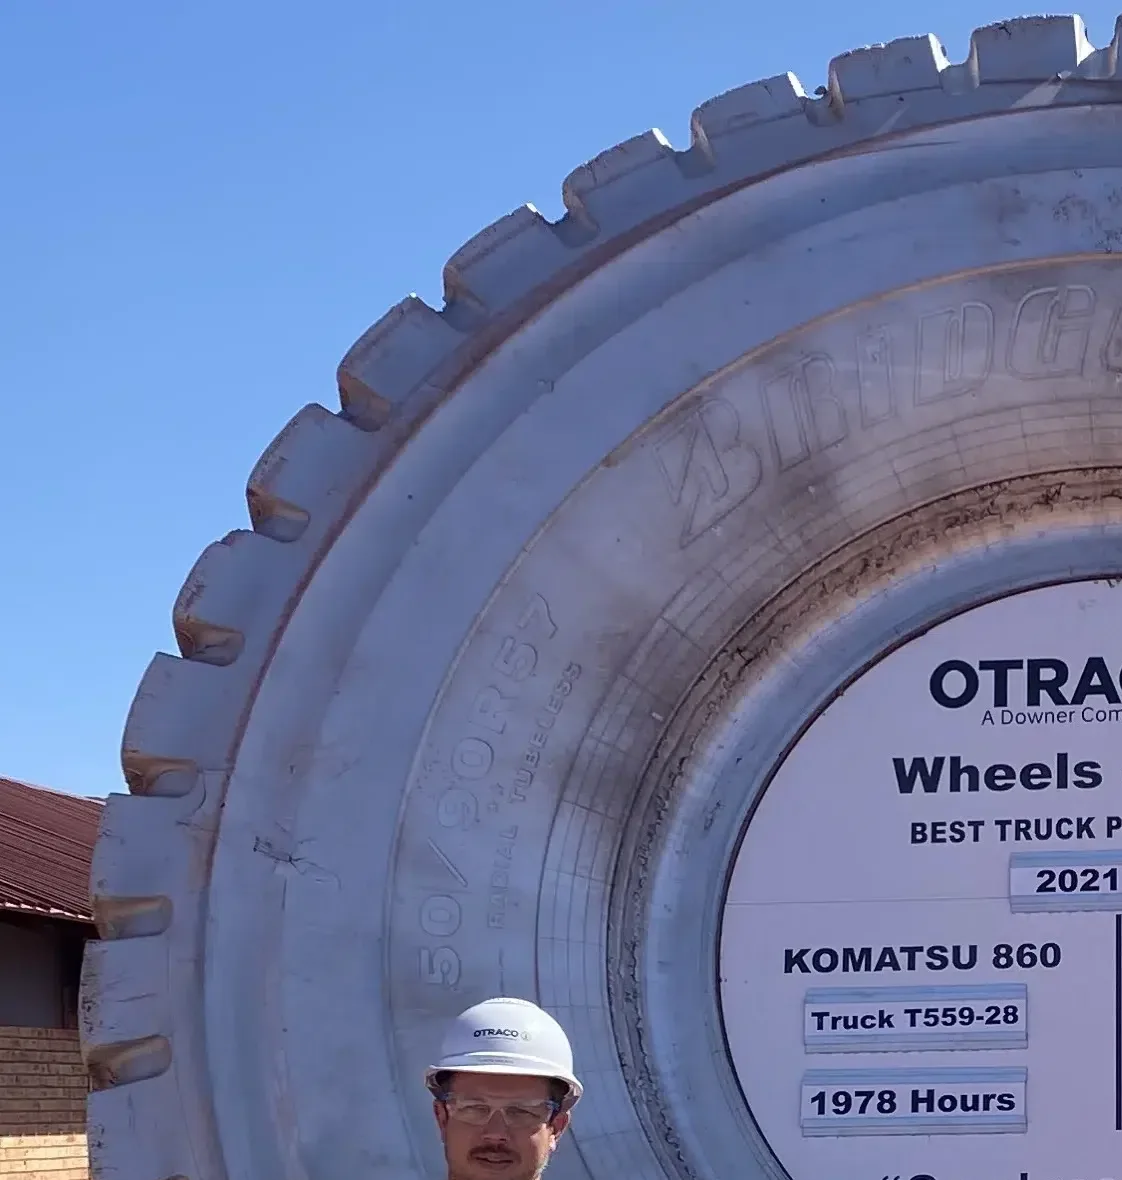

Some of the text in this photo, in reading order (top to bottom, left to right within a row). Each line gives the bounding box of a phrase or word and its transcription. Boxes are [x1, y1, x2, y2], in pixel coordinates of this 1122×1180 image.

[981, 709, 995, 726] A
[1000, 708, 1076, 725] Downer
[891, 752, 1103, 794] Wheels
[910, 820, 985, 845] BEST
[994, 816, 1096, 842] TRUCK
[1035, 867, 1118, 893] 2021
[783, 942, 1062, 974] KOMATSU 860
[811, 1004, 1019, 1031] Truck T559-28
[473, 1028, 519, 1037] OTRACO
[810, 1088, 1016, 1116] 1978 Hours
